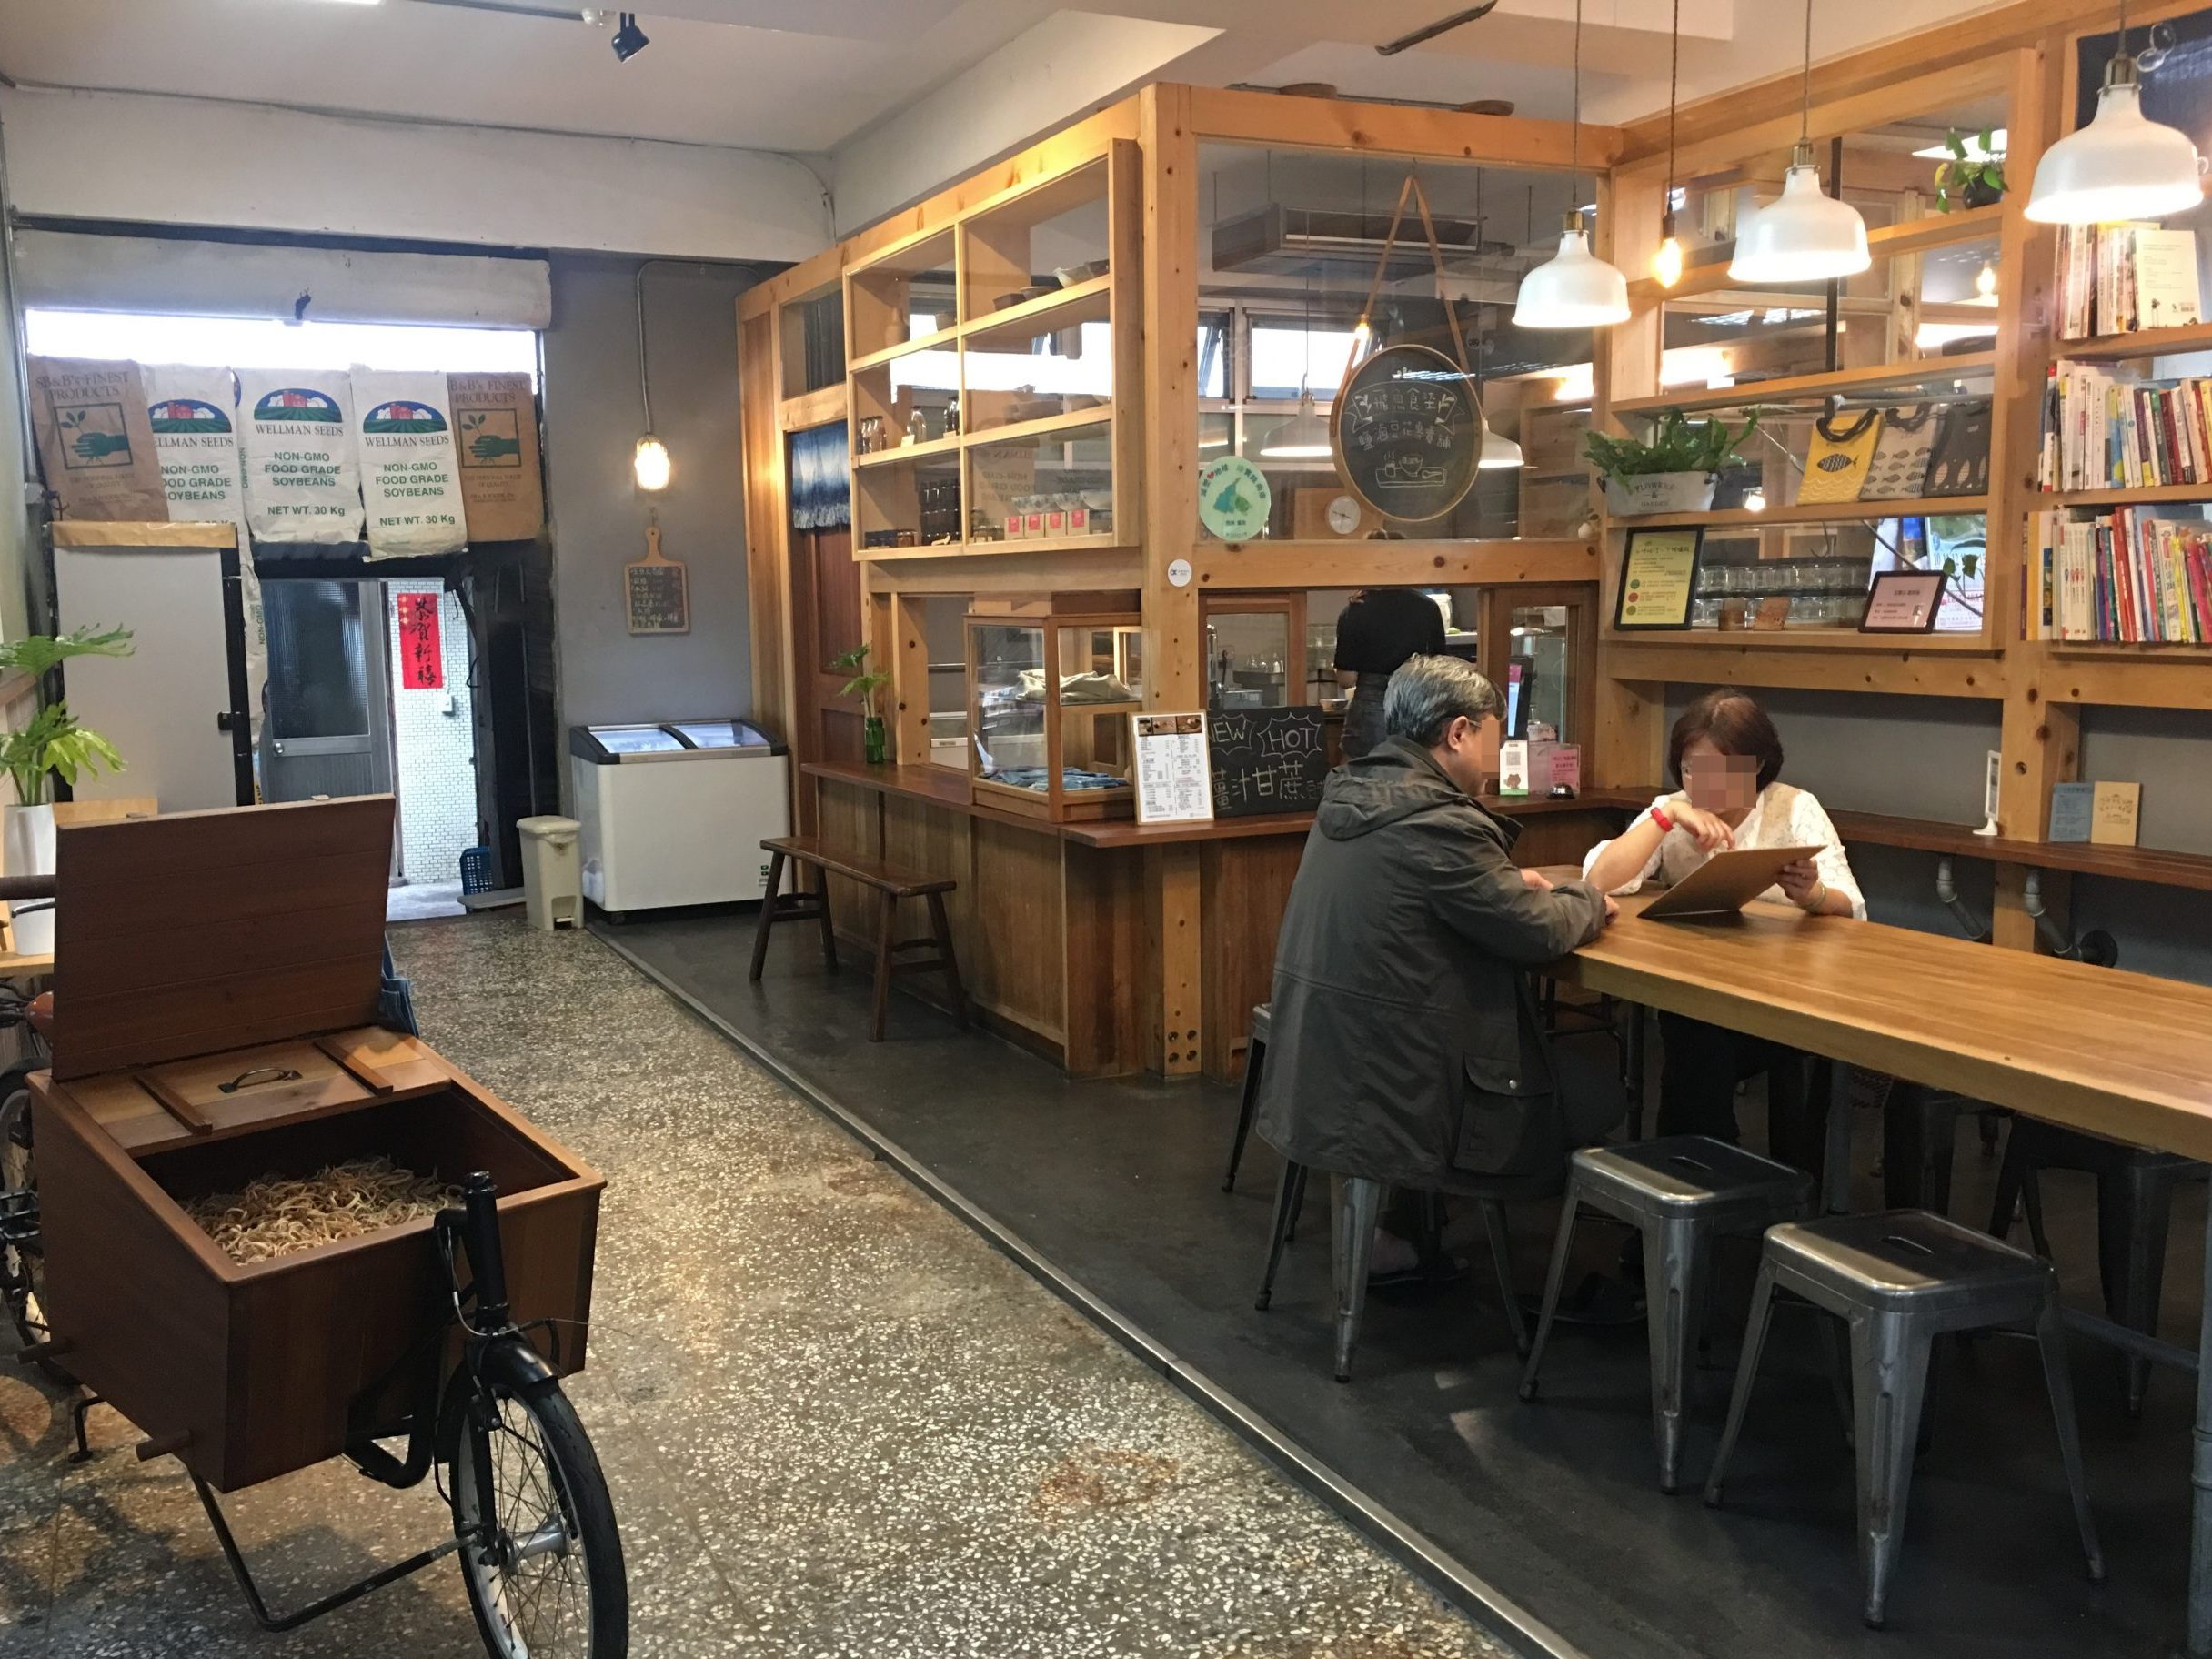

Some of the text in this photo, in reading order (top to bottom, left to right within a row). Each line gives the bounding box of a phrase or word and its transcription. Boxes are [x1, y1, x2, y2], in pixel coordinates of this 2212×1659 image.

[85, 370, 130, 385] FINEST
[488, 378, 525, 391] FINEST
[48, 385, 121, 400] PRODUCTS
[455, 392, 516, 403] PRODUCTS
[255, 424, 344, 437] WELLMAN SEEDS
[200, 437, 234, 447] SEEDS
[365, 435, 450, 447] WELLMAN SEEDS
[274, 451, 330, 462] NON-GMO
[161, 465, 219, 475] NON-GMO
[238, 447, 249, 489] NON-GMO
[265, 464, 341, 475] FOOD GRADE
[384, 462, 437, 472] NON-GMO
[189, 478, 232, 488] GRADE
[273, 477, 336, 487] SOYBEANS
[376, 474, 449, 485] FOOD GRADE
[166, 491, 226, 501] OYBEANS
[384, 487, 444, 498] SOYBEANS
[267, 506, 346, 517] NET WT. 30 Kg
[379, 514, 455, 526] NET WT. 30 Kg
[1268, 728, 1314, 751] HOT
